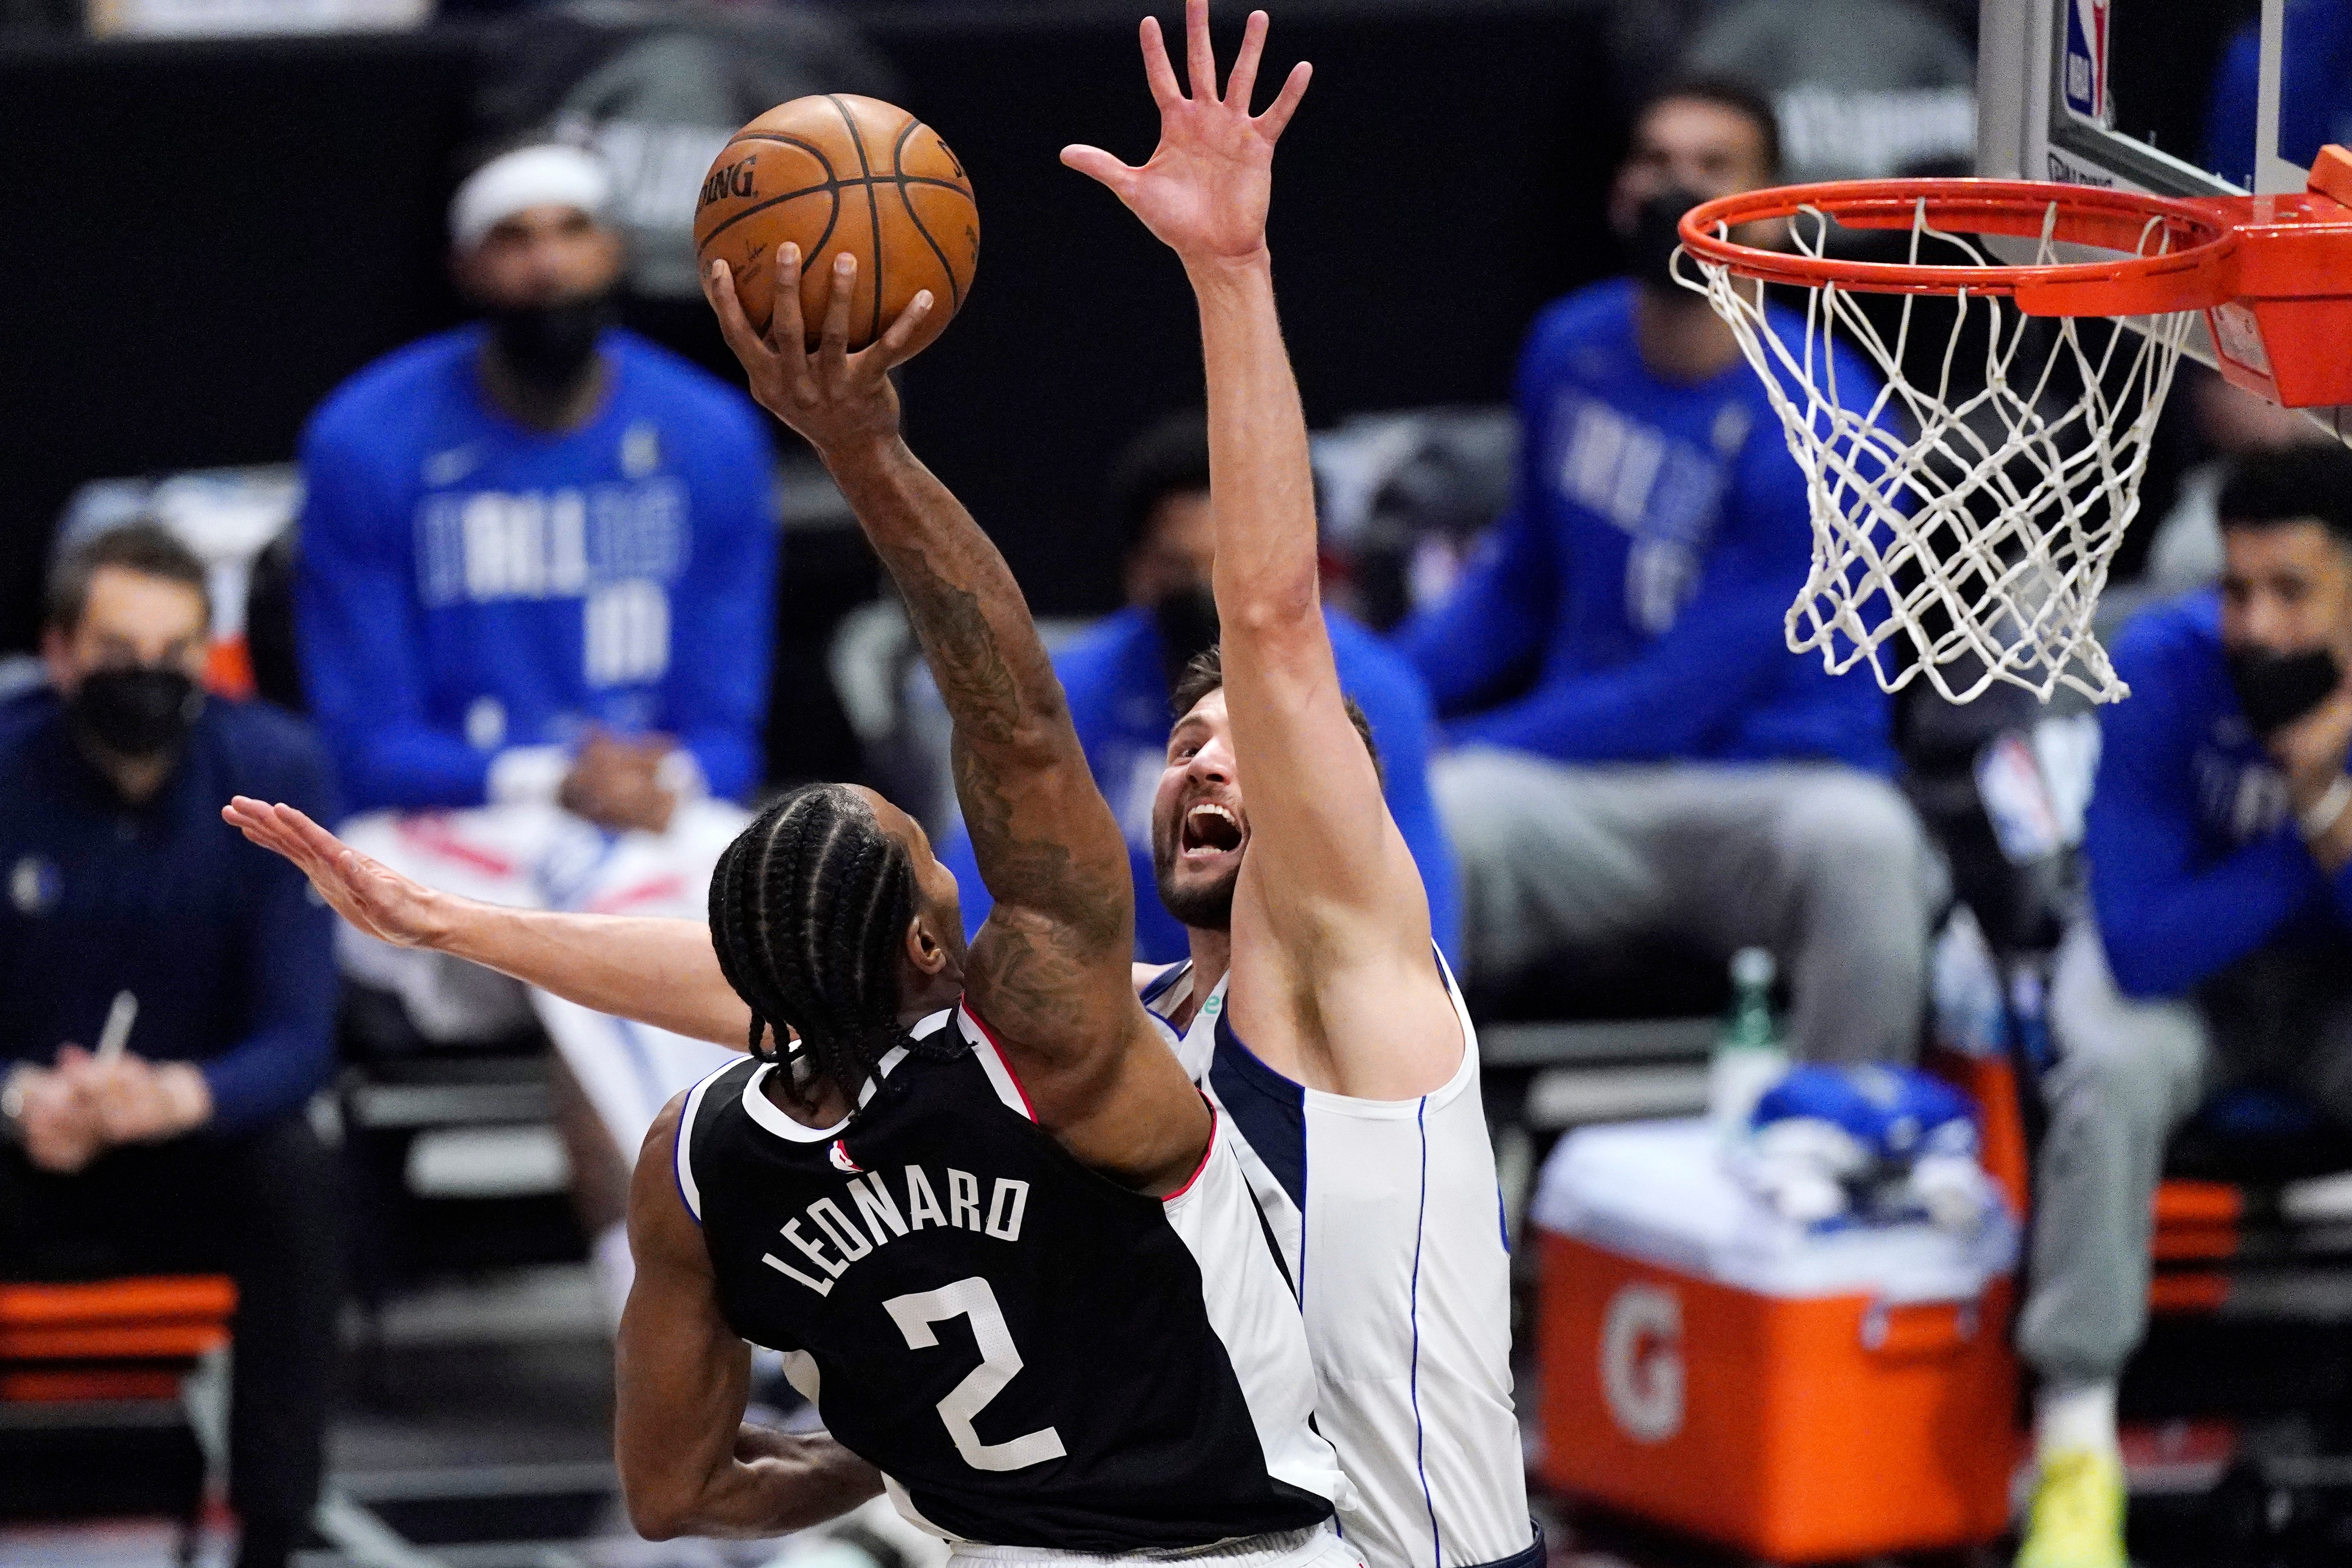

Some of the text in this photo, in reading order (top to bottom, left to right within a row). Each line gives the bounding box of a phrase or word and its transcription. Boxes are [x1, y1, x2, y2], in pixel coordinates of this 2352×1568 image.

[762, 1164, 1029, 1297] LEONARD
[882, 1276, 1067, 1472] 2
[1604, 1282, 1687, 1442] G
